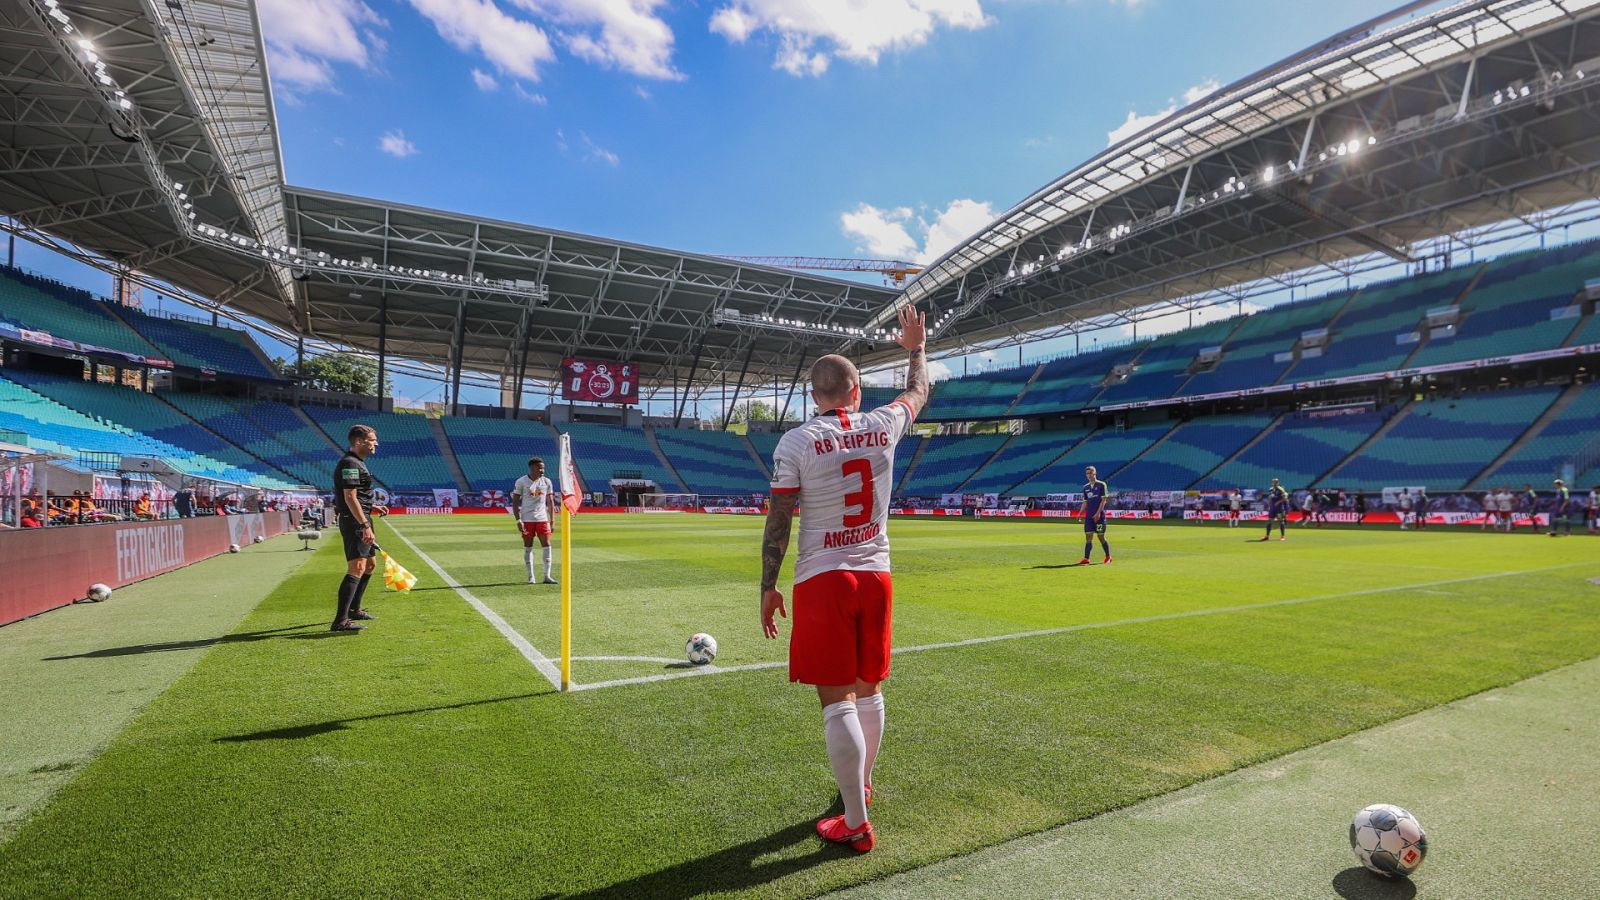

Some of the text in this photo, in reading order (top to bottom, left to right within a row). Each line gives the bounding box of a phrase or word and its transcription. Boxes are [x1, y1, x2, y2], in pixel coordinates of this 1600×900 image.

[571, 377, 582, 392] 0
[620, 381, 630, 395] 0
[814, 431, 889, 455] RB LEIPZIG
[841, 458, 875, 528] 3
[406, 506, 453, 515] FERTIGKELLER
[115, 523, 186, 583] FERTIGKELLER
